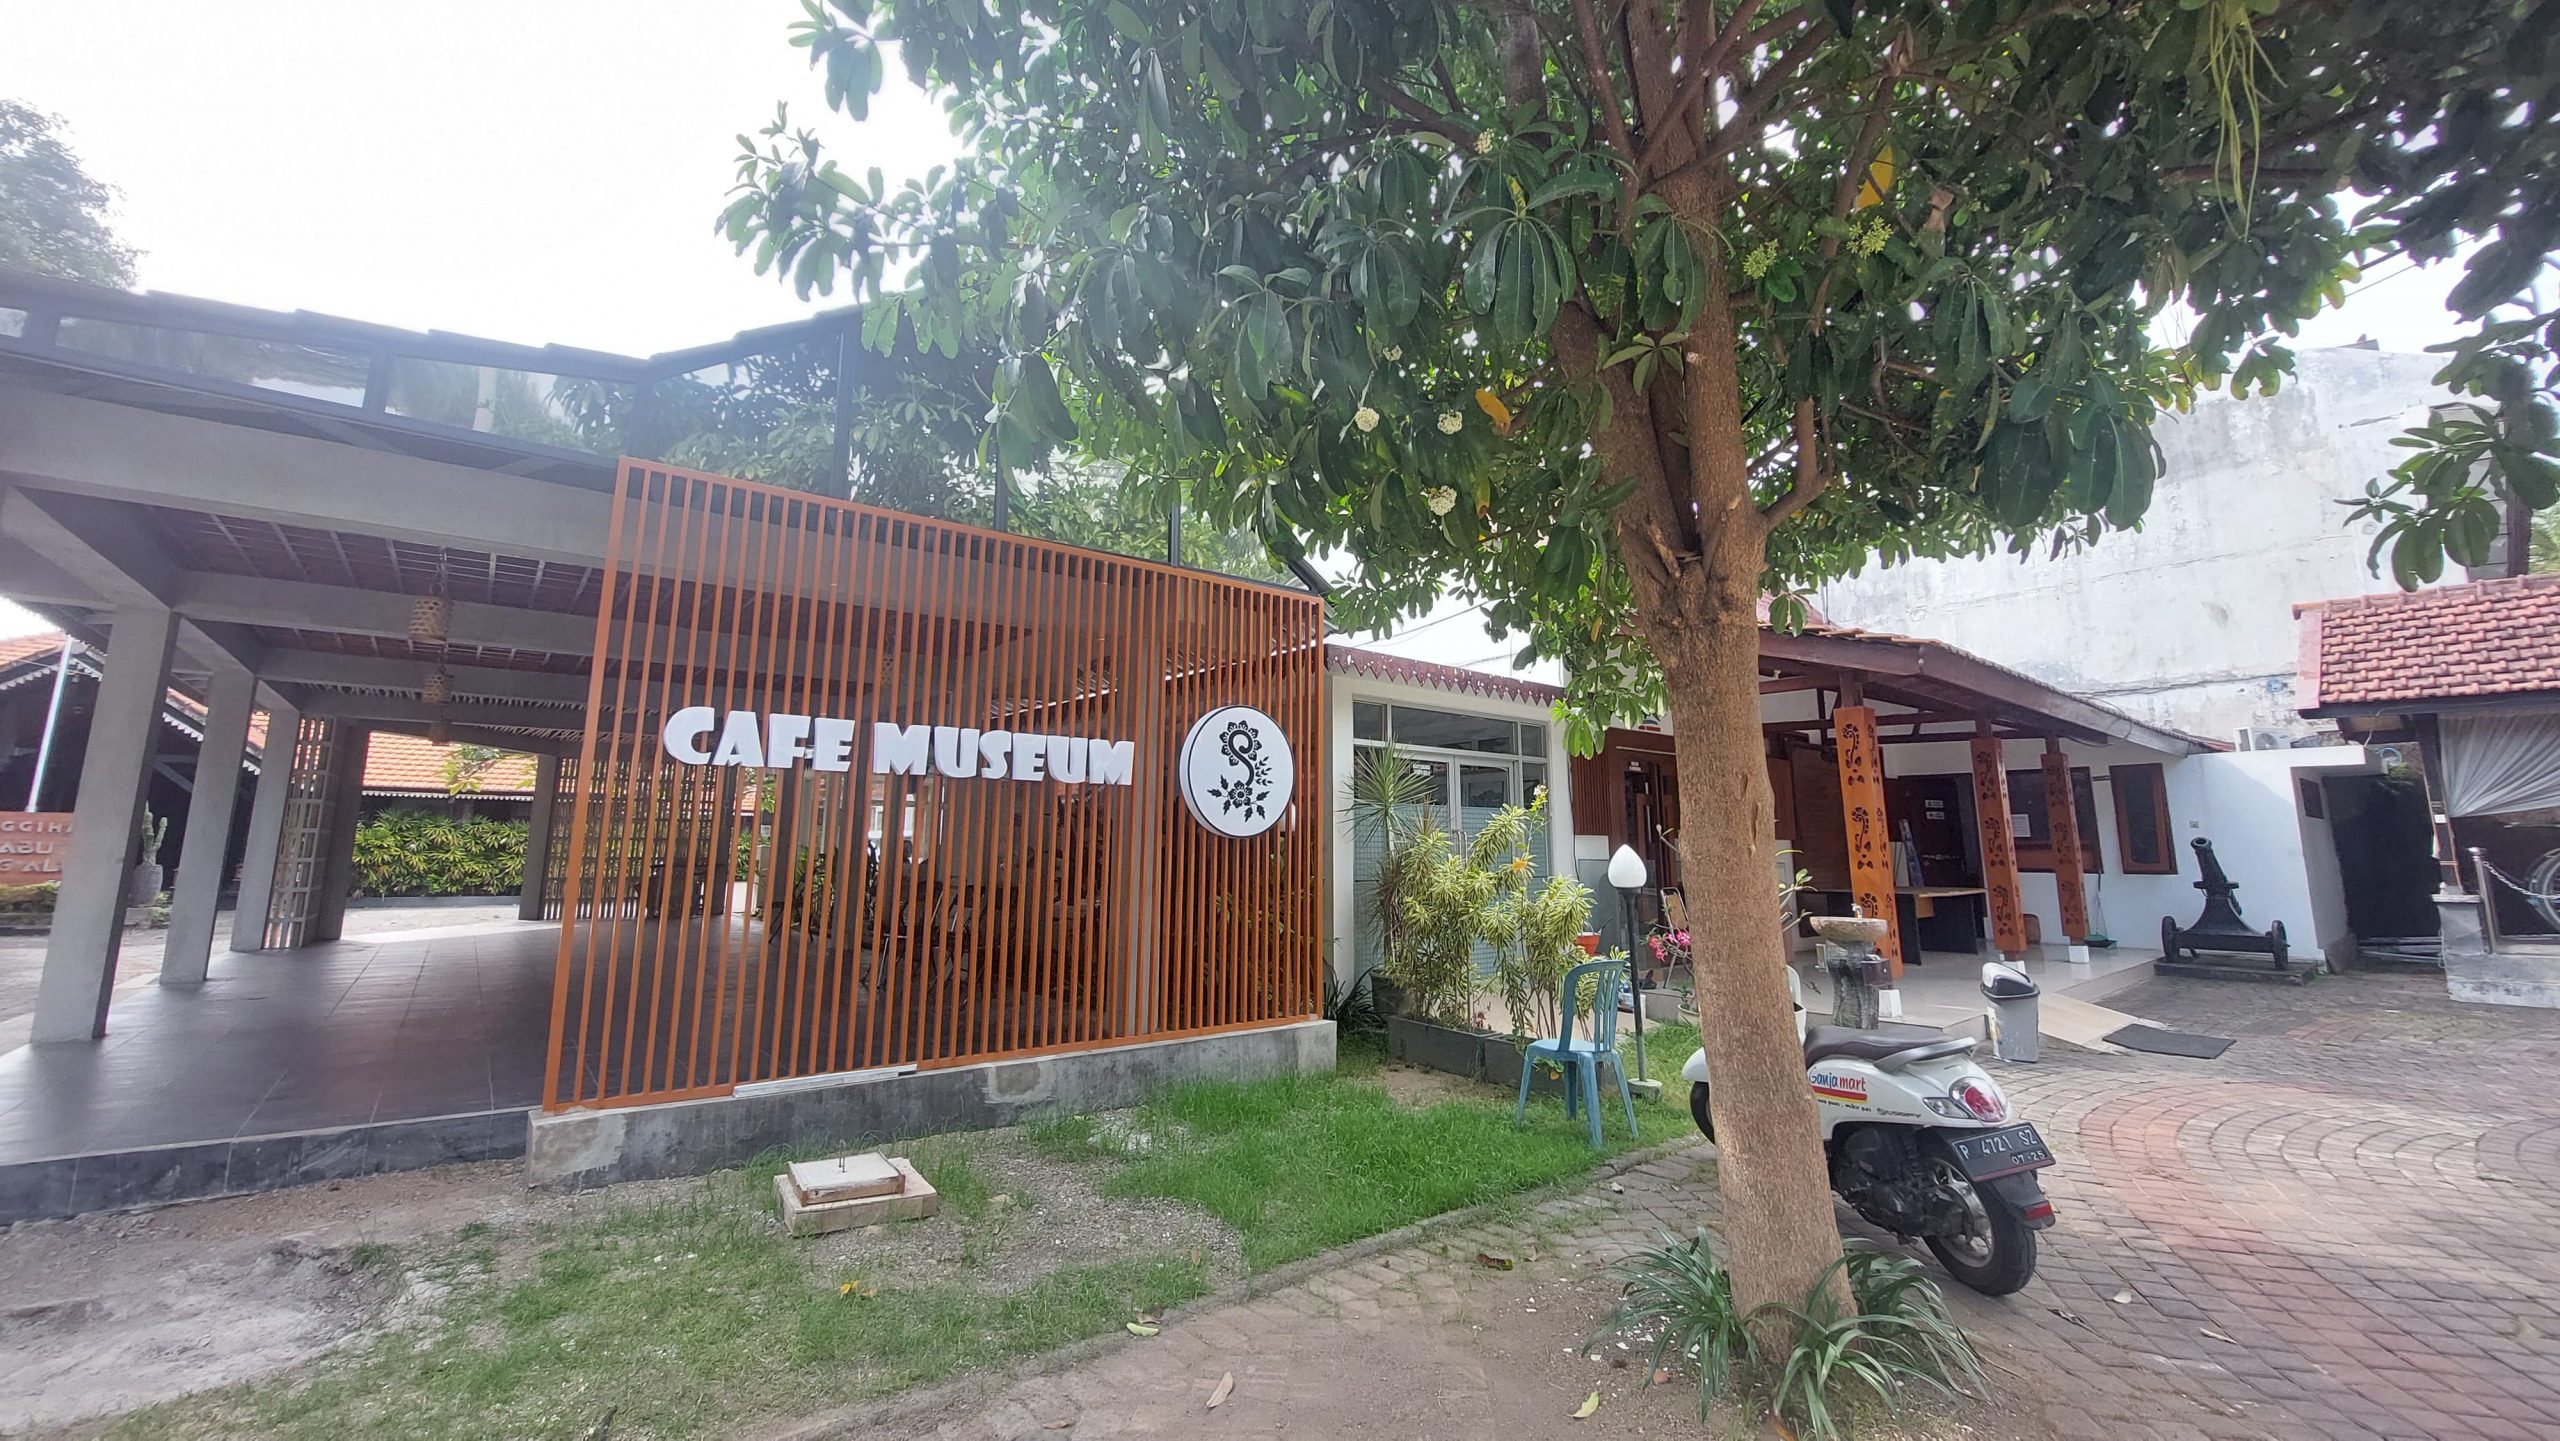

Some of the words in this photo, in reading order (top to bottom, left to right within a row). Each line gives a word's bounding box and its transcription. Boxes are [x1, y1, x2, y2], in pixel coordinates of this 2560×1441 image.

[663, 706, 855, 772] CAFE
[873, 722, 1135, 785] MUSEUM
[1839, 1077, 1867, 1091] mart
[1959, 1145, 1969, 1160] P
[1981, 1135, 2013, 1154] 4721
[2018, 1129, 2037, 1146] SZ
